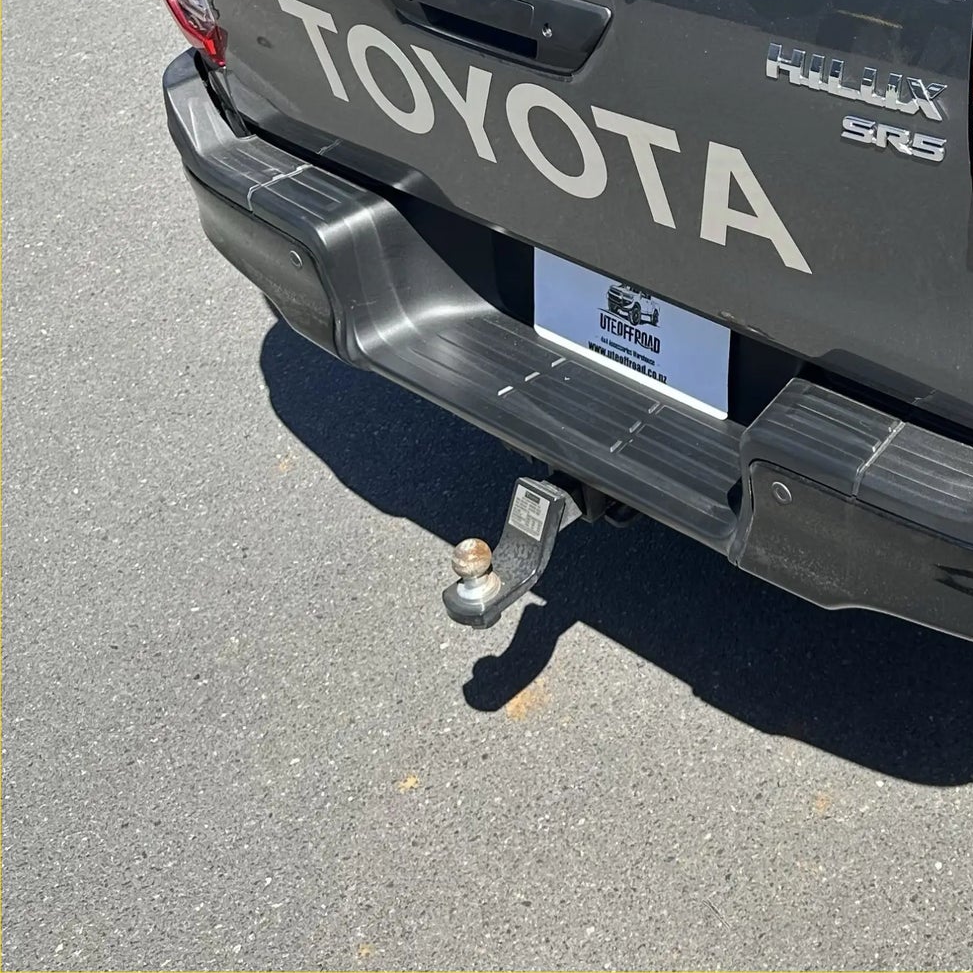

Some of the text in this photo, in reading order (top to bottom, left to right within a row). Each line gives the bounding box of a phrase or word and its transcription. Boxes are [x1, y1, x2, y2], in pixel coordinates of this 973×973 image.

[765, 41, 948, 122] HILUX
[840, 114, 947, 162] SR5
[599, 312, 661, 354] UTEOFFROAD
[588, 340, 668, 384] www.uteoffroad.co.nz
